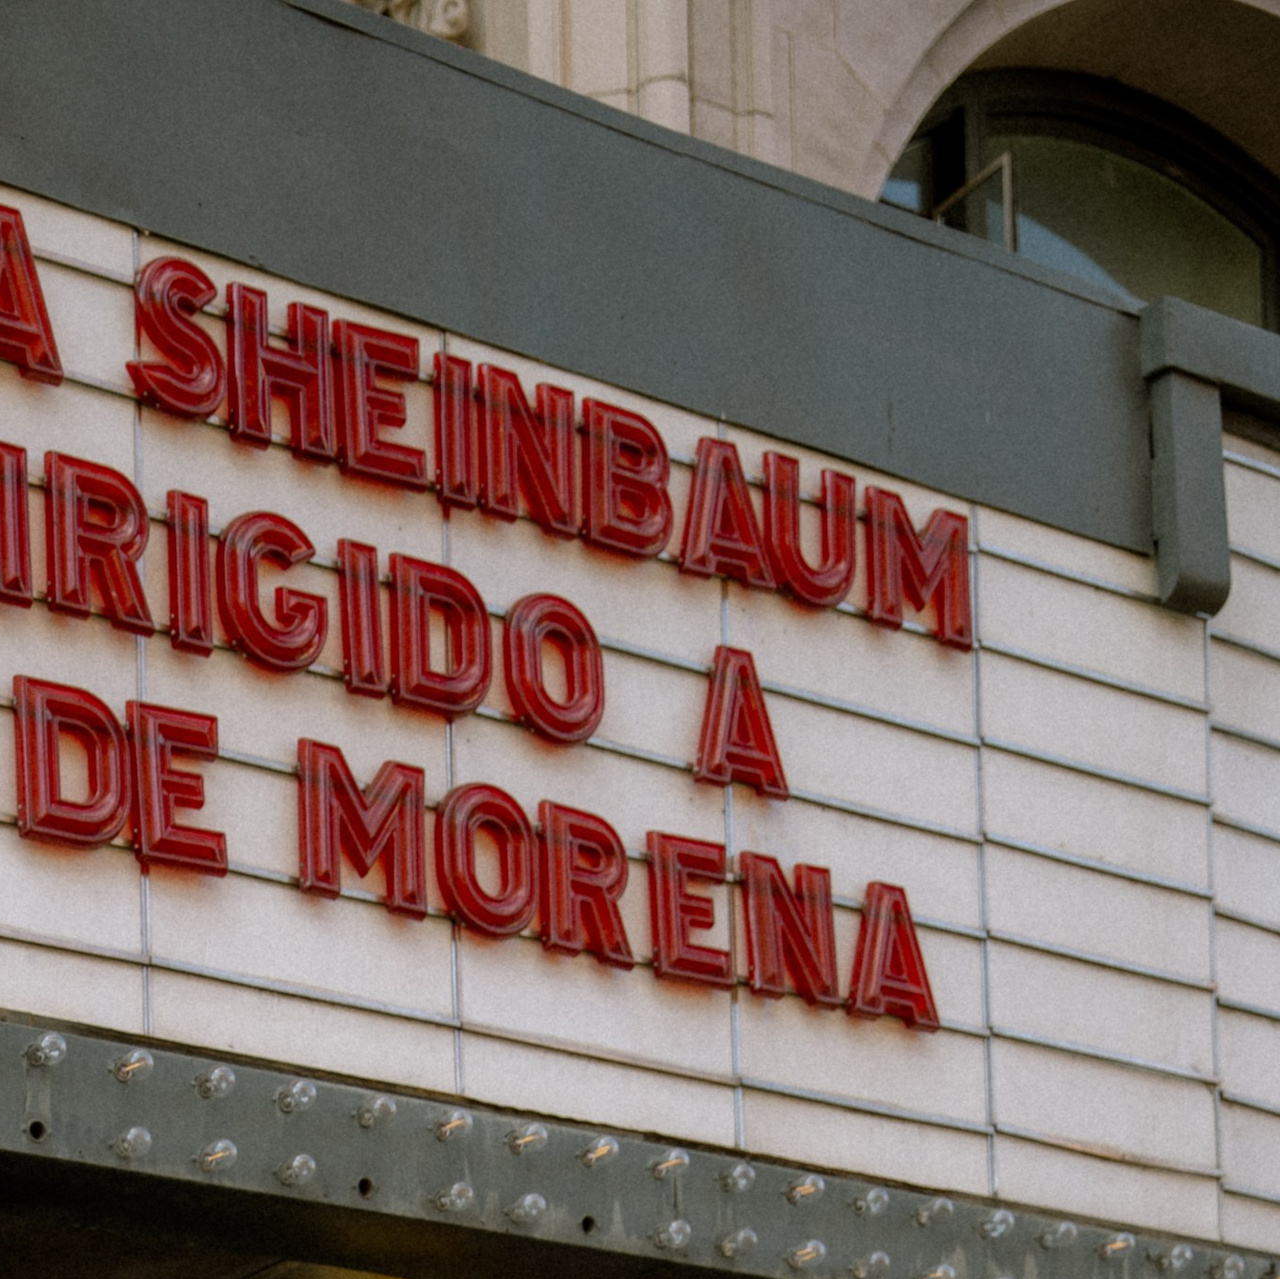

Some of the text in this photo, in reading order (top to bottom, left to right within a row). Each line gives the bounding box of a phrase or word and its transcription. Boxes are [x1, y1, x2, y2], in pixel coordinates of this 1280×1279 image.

[126, 256, 972, 651] SHEINBAUM
[12, 675, 228, 877] DE
[297, 738, 939, 1032] MORENA
[693, 645, 789, 800] A
